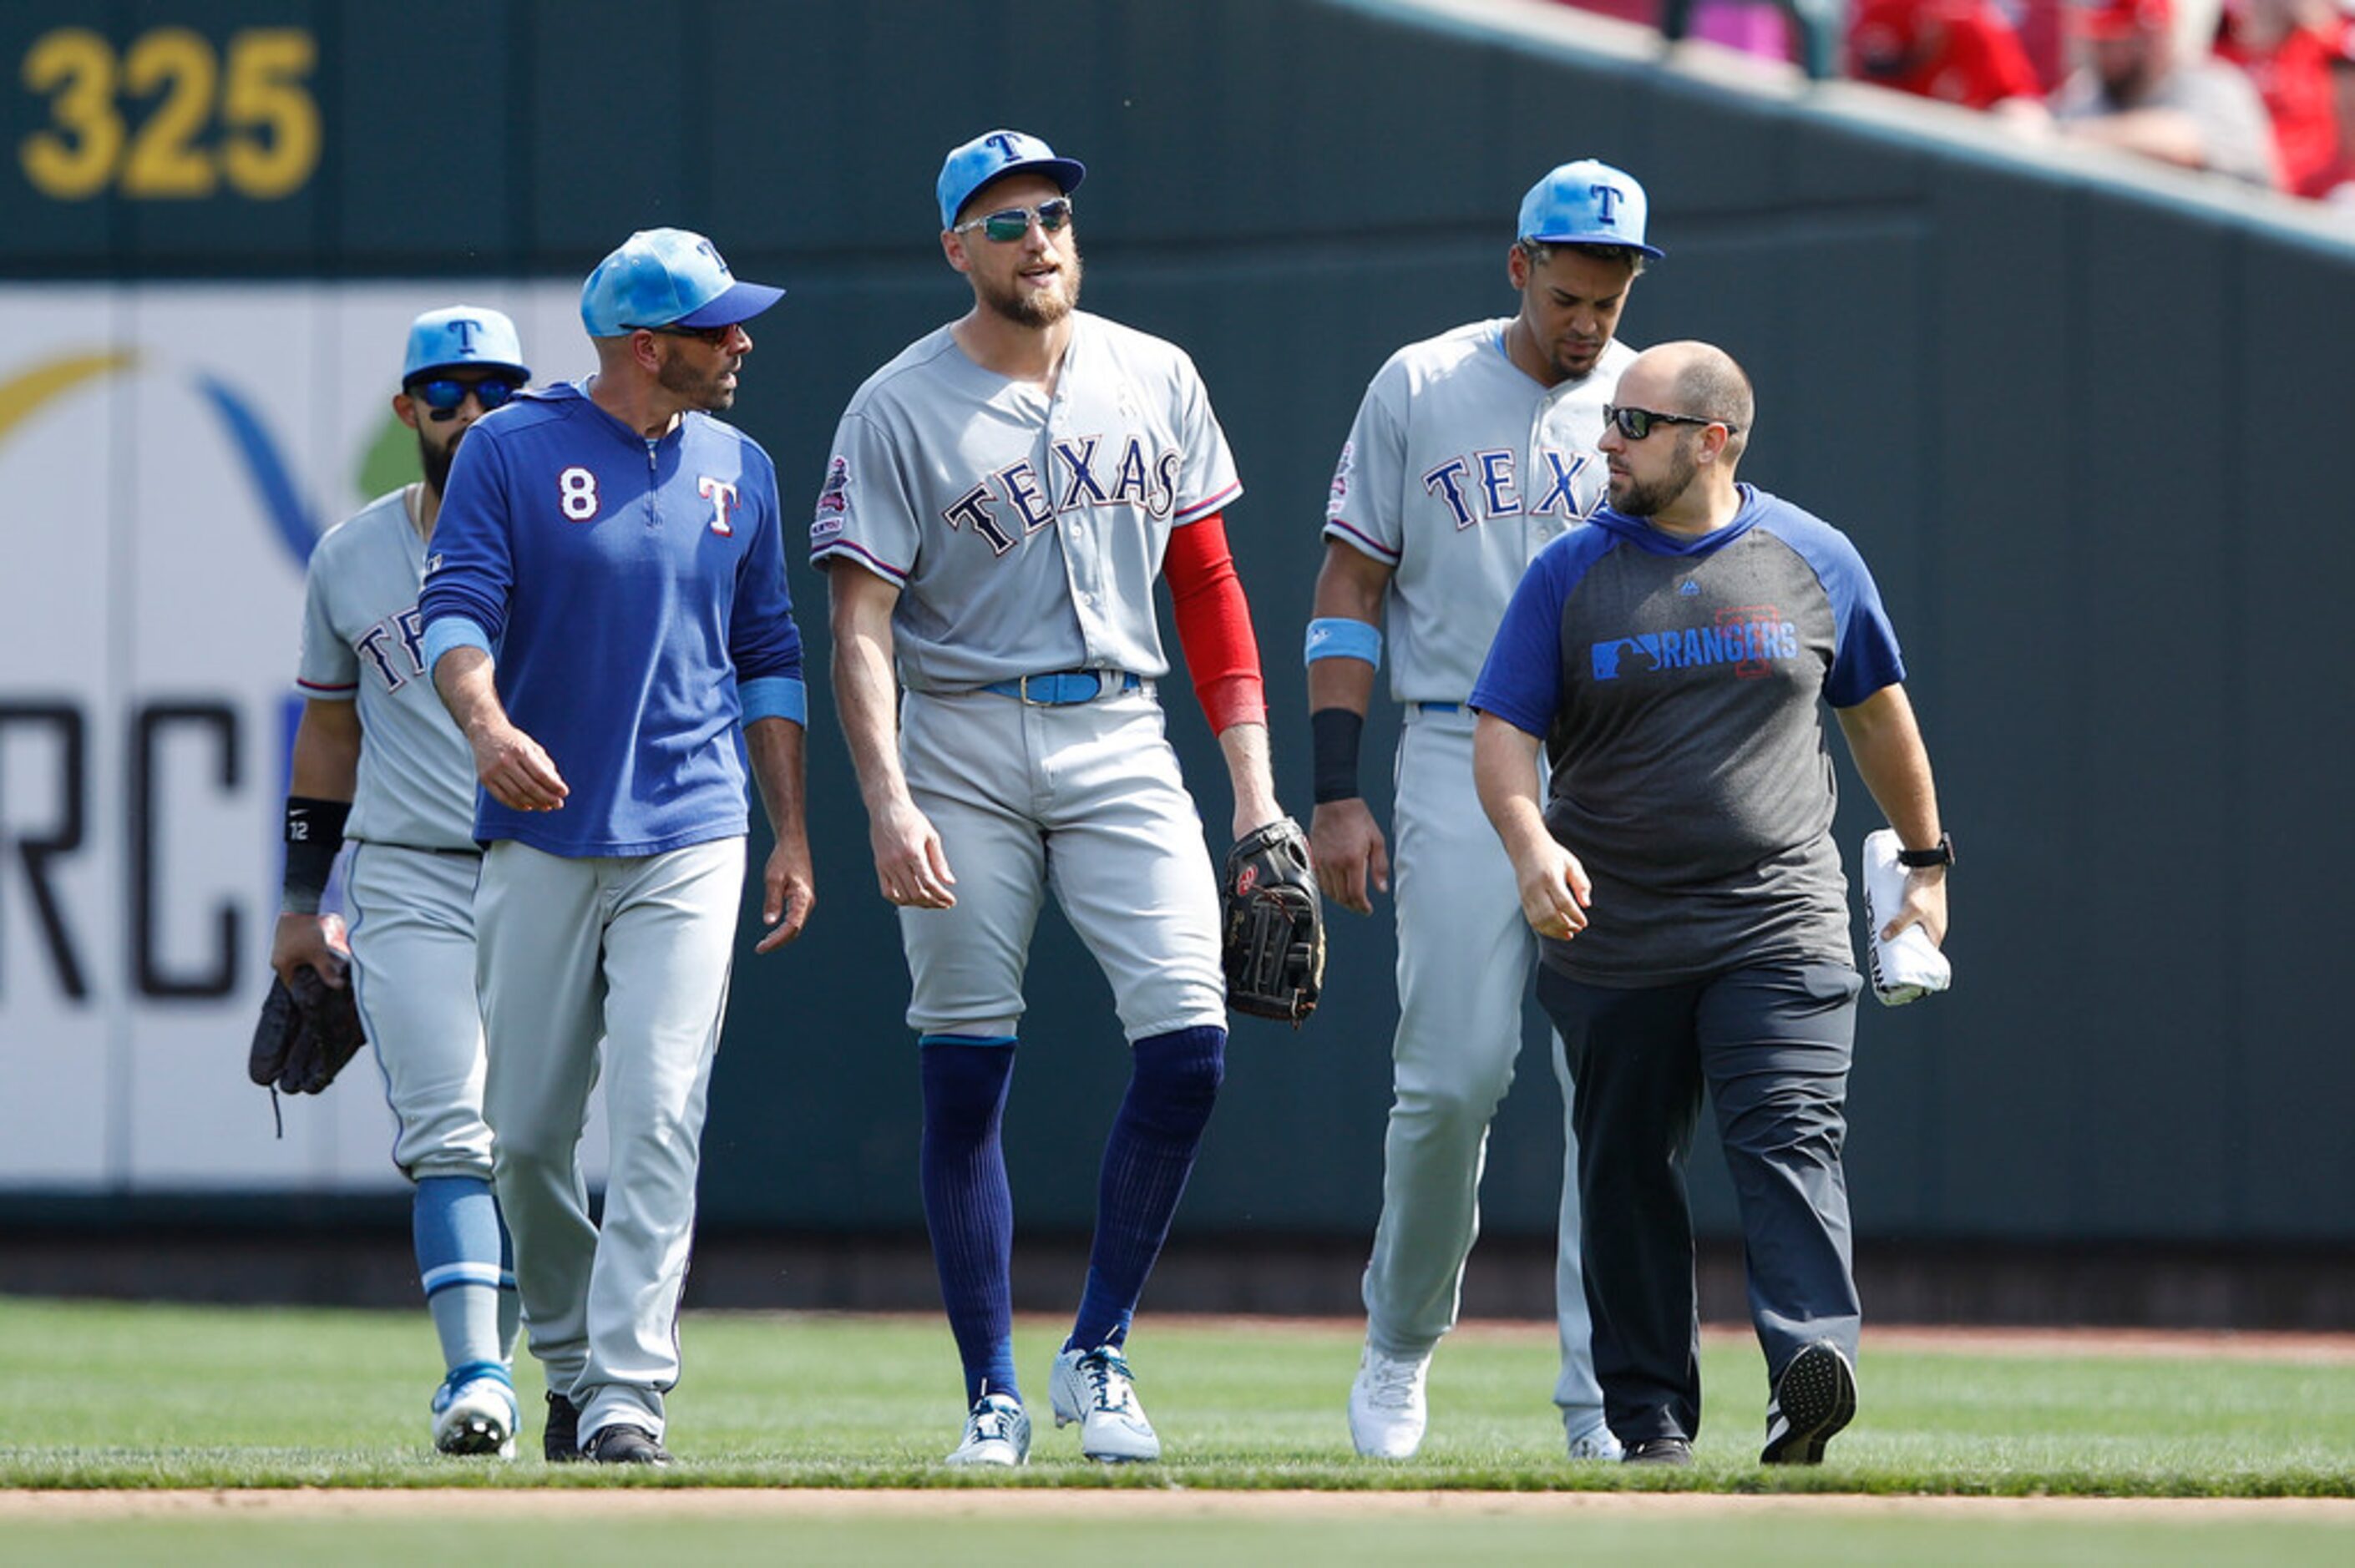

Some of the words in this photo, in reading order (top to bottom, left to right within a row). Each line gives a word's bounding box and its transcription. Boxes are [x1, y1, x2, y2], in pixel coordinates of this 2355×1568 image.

[22, 28, 322, 199] 325
[985, 133, 1023, 162] T
[1590, 184, 1624, 225] T
[446, 319, 483, 355] T
[558, 464, 601, 524] 8
[697, 475, 741, 538] T
[941, 434, 1183, 558] TEXAS
[1660, 623, 1798, 670] RANGERS
[289, 821, 308, 840] 12
